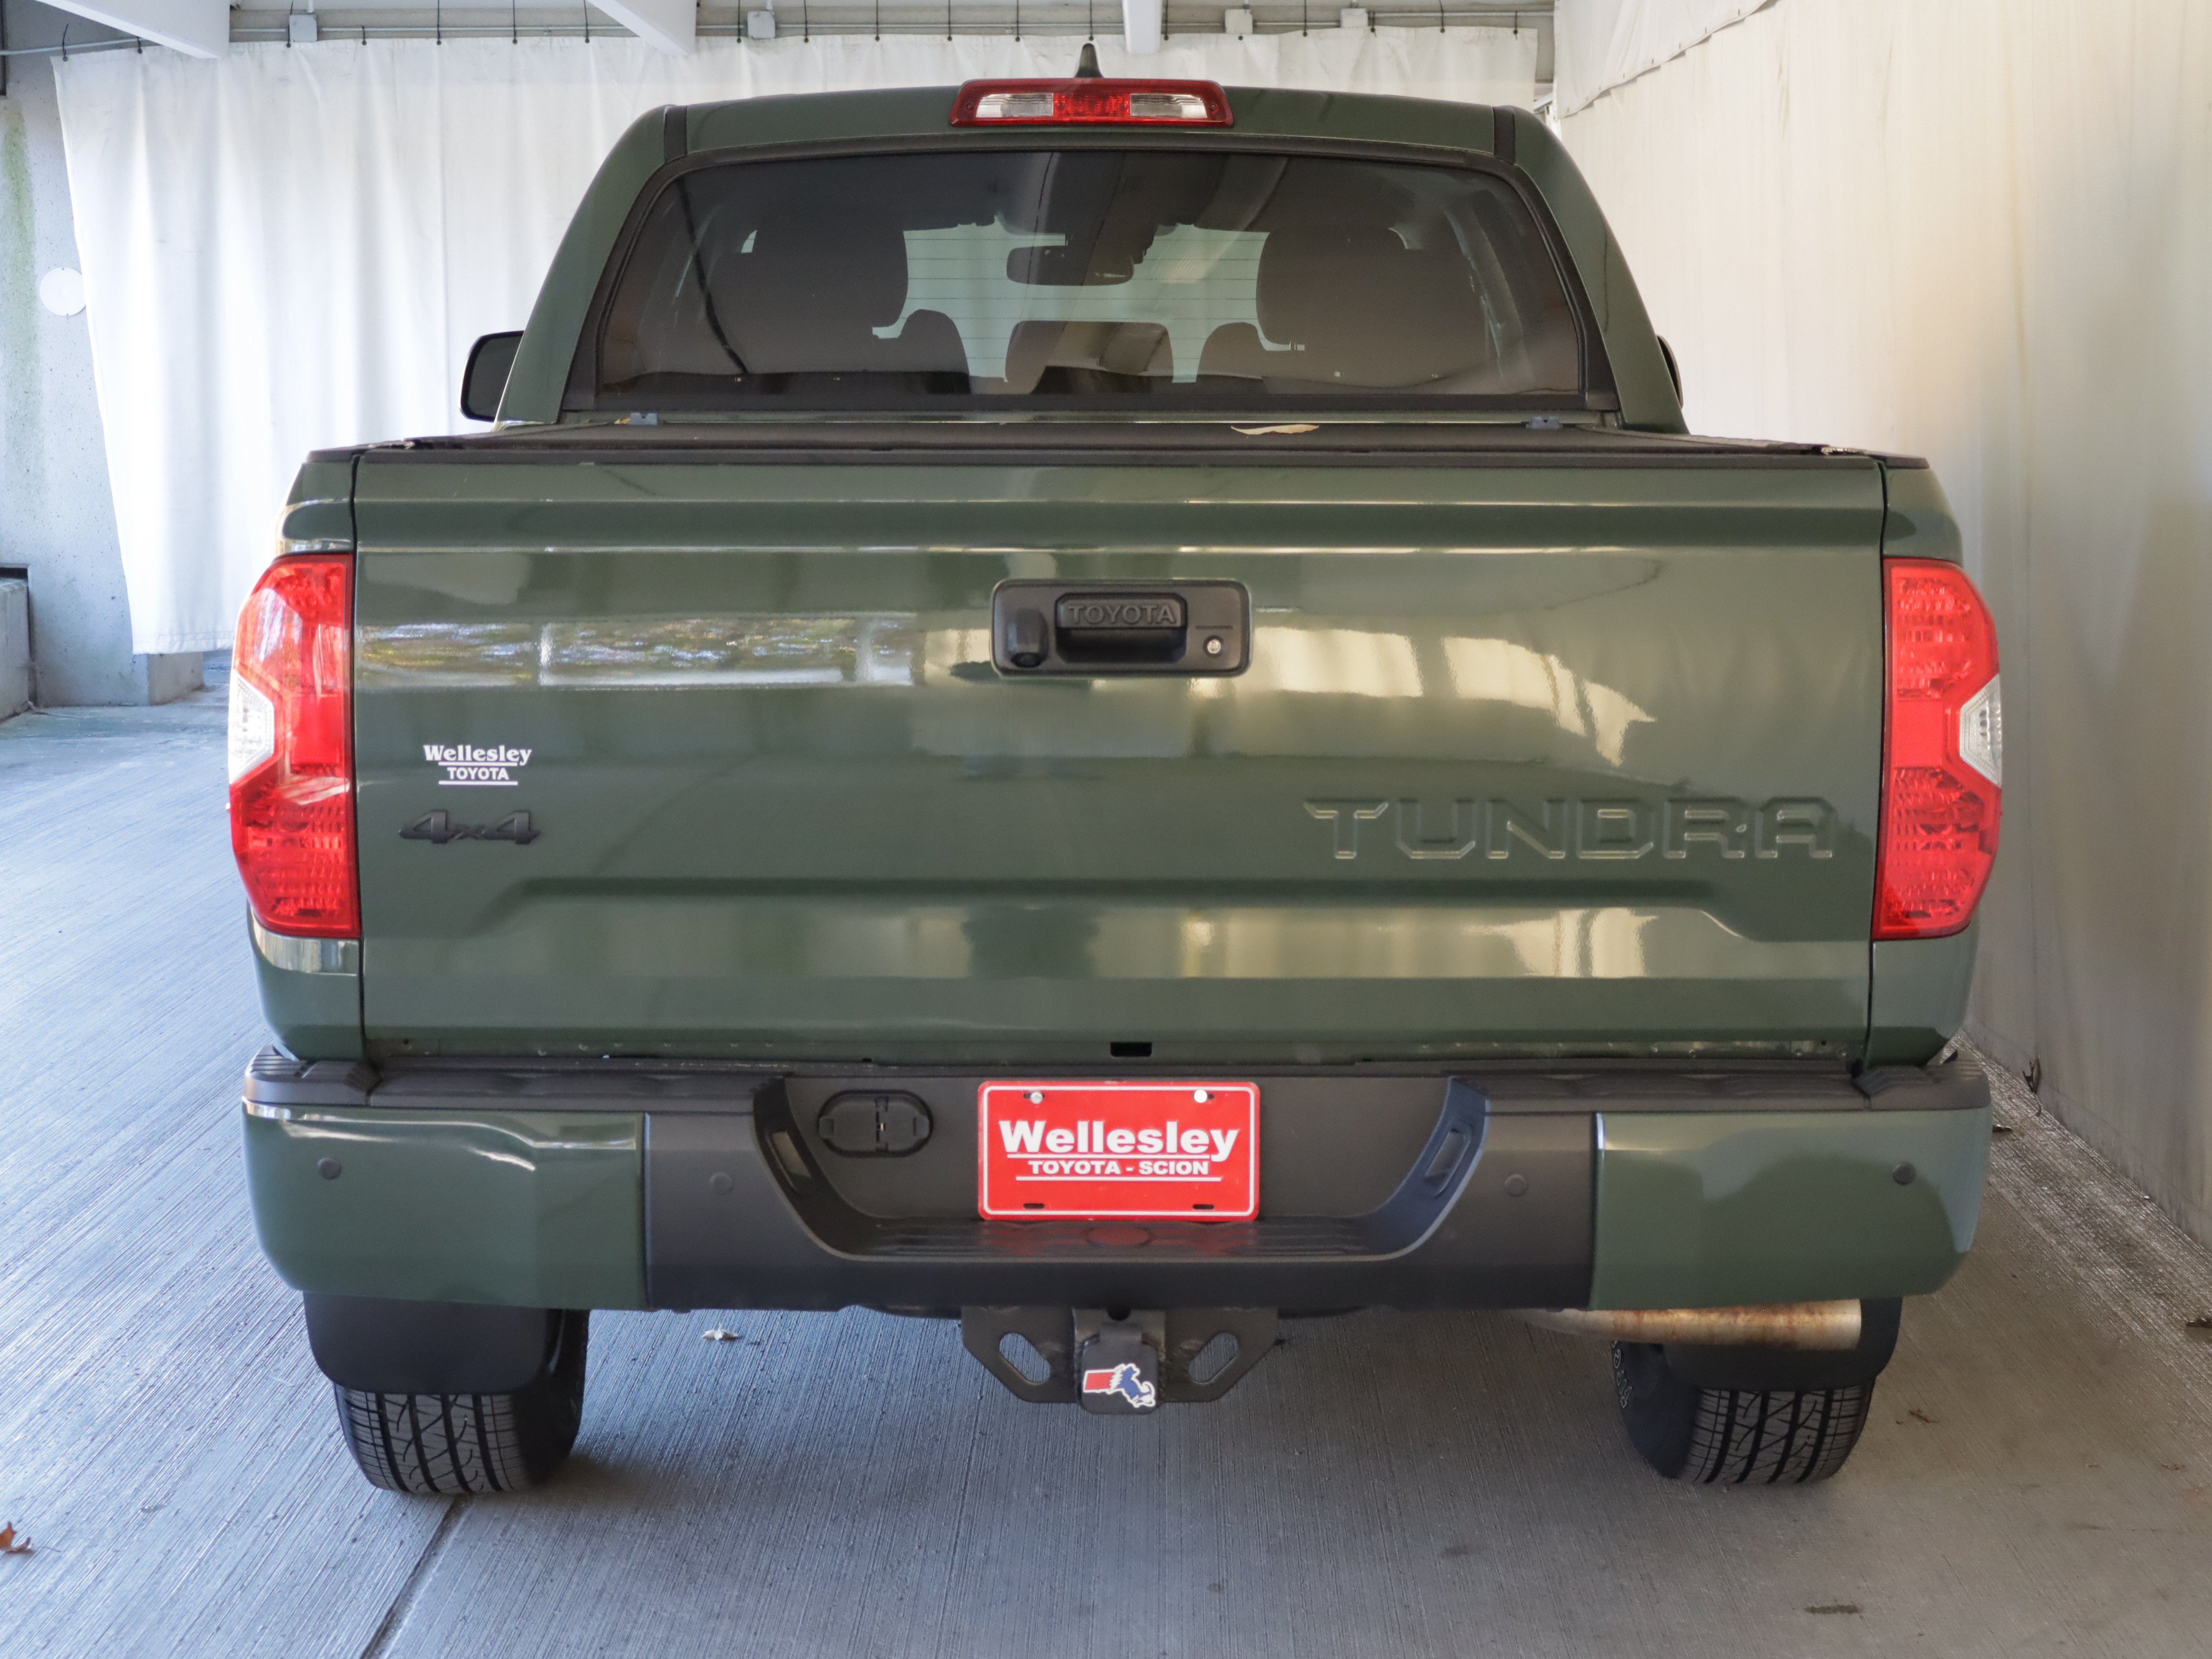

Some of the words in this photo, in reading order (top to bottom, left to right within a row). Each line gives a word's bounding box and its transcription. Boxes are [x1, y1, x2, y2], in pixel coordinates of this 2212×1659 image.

[1068, 605, 1177, 624] TOYOTA
[423, 745, 532, 766] Wellesley
[447, 767, 509, 780] TOYOTA
[1303, 796, 1838, 860] TUNDRA
[999, 1120, 1240, 1162] Wellesley
[1028, 1160, 1121, 1175] TOYOTA
[1138, 1160, 1209, 1175] SCION
